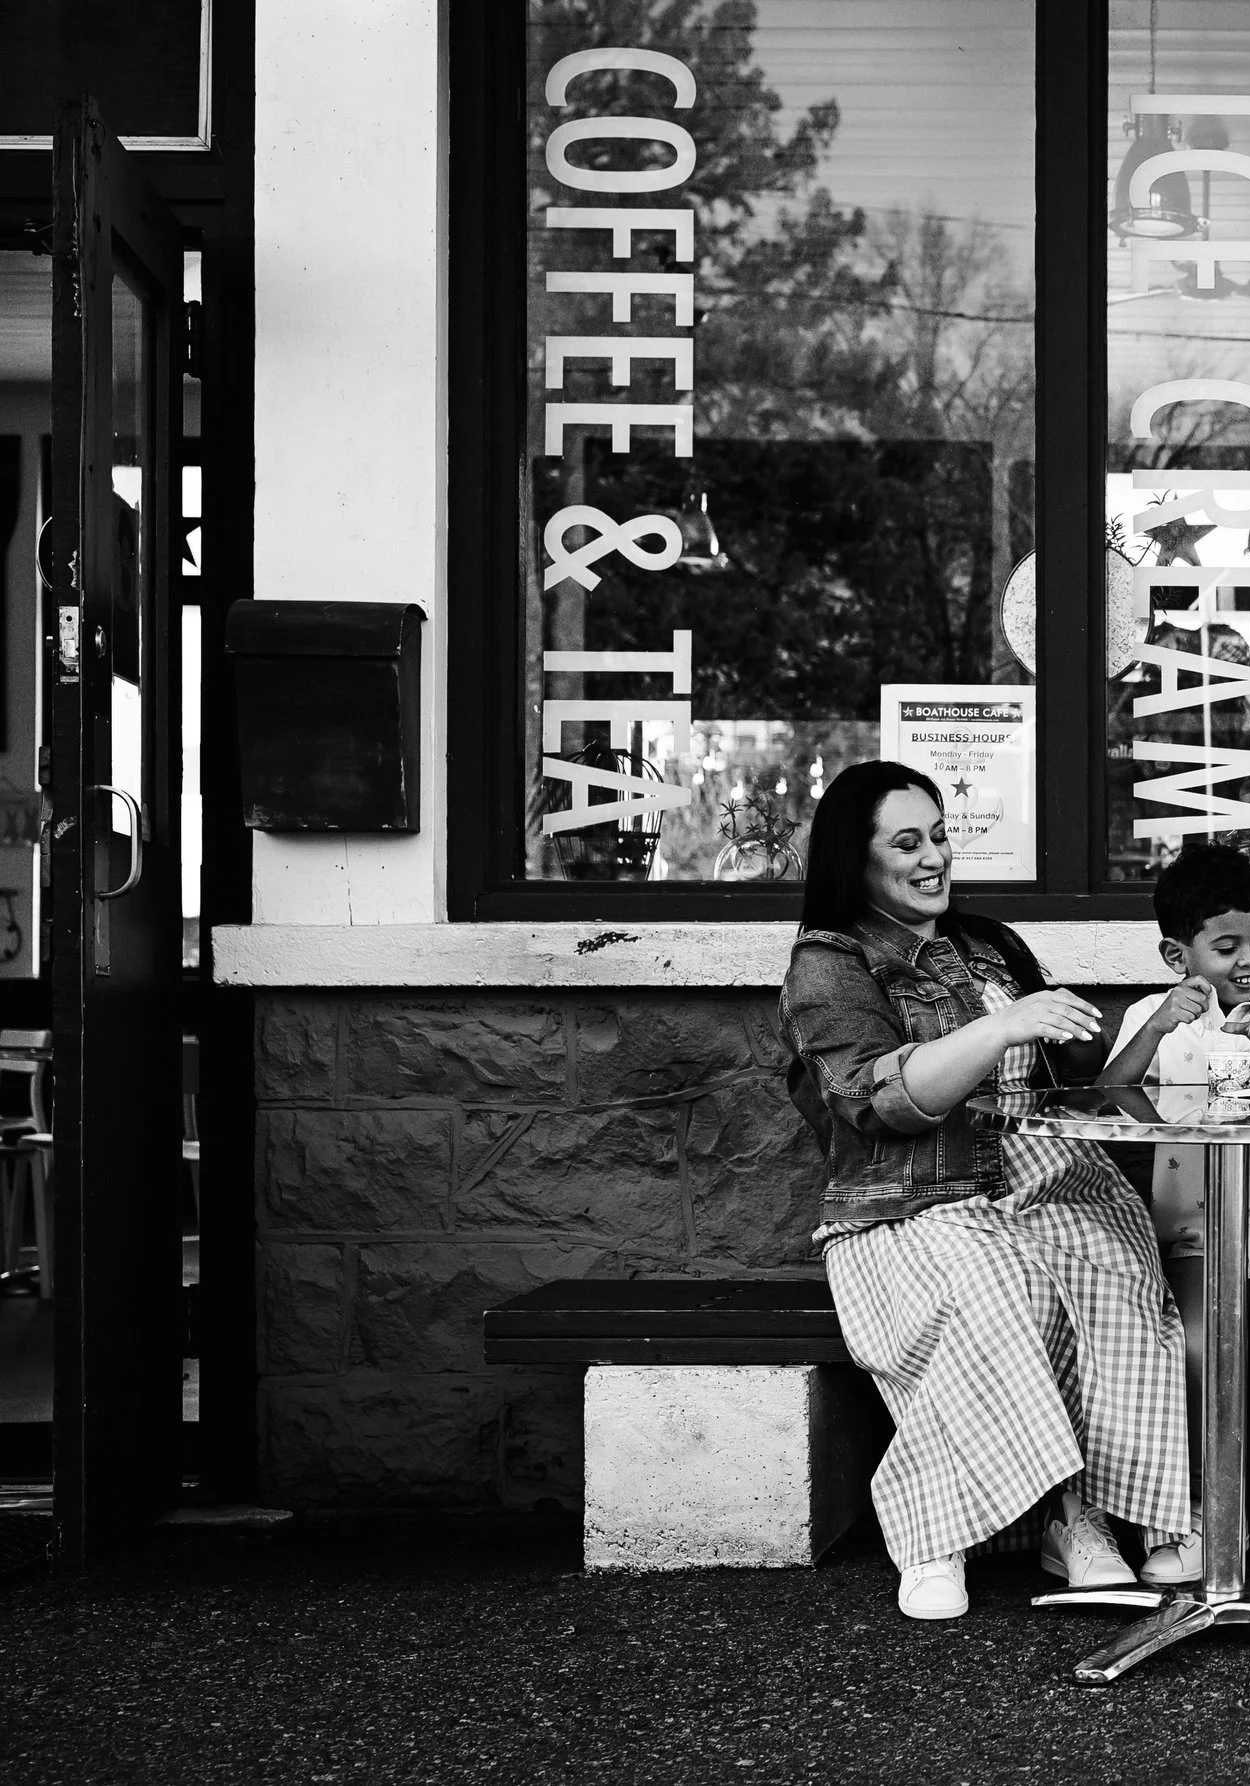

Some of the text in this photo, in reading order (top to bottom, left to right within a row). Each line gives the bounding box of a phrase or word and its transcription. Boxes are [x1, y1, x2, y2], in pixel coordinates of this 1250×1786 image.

[542, 47, 697, 836] COFFEE & TEA
[915, 706, 1010, 719] BOATHOUSE CAFE
[911, 732, 970, 743] BUSINESS
[929, 750, 962, 760] Monday
[968, 750, 994, 759] Friday
[933, 762, 944, 771] 10
[961, 812, 968, 820] &
[969, 812, 1000, 822] Sunday
[946, 826, 960, 834] AM
[967, 826, 973, 834] 8
[975, 826, 988, 834] PM
